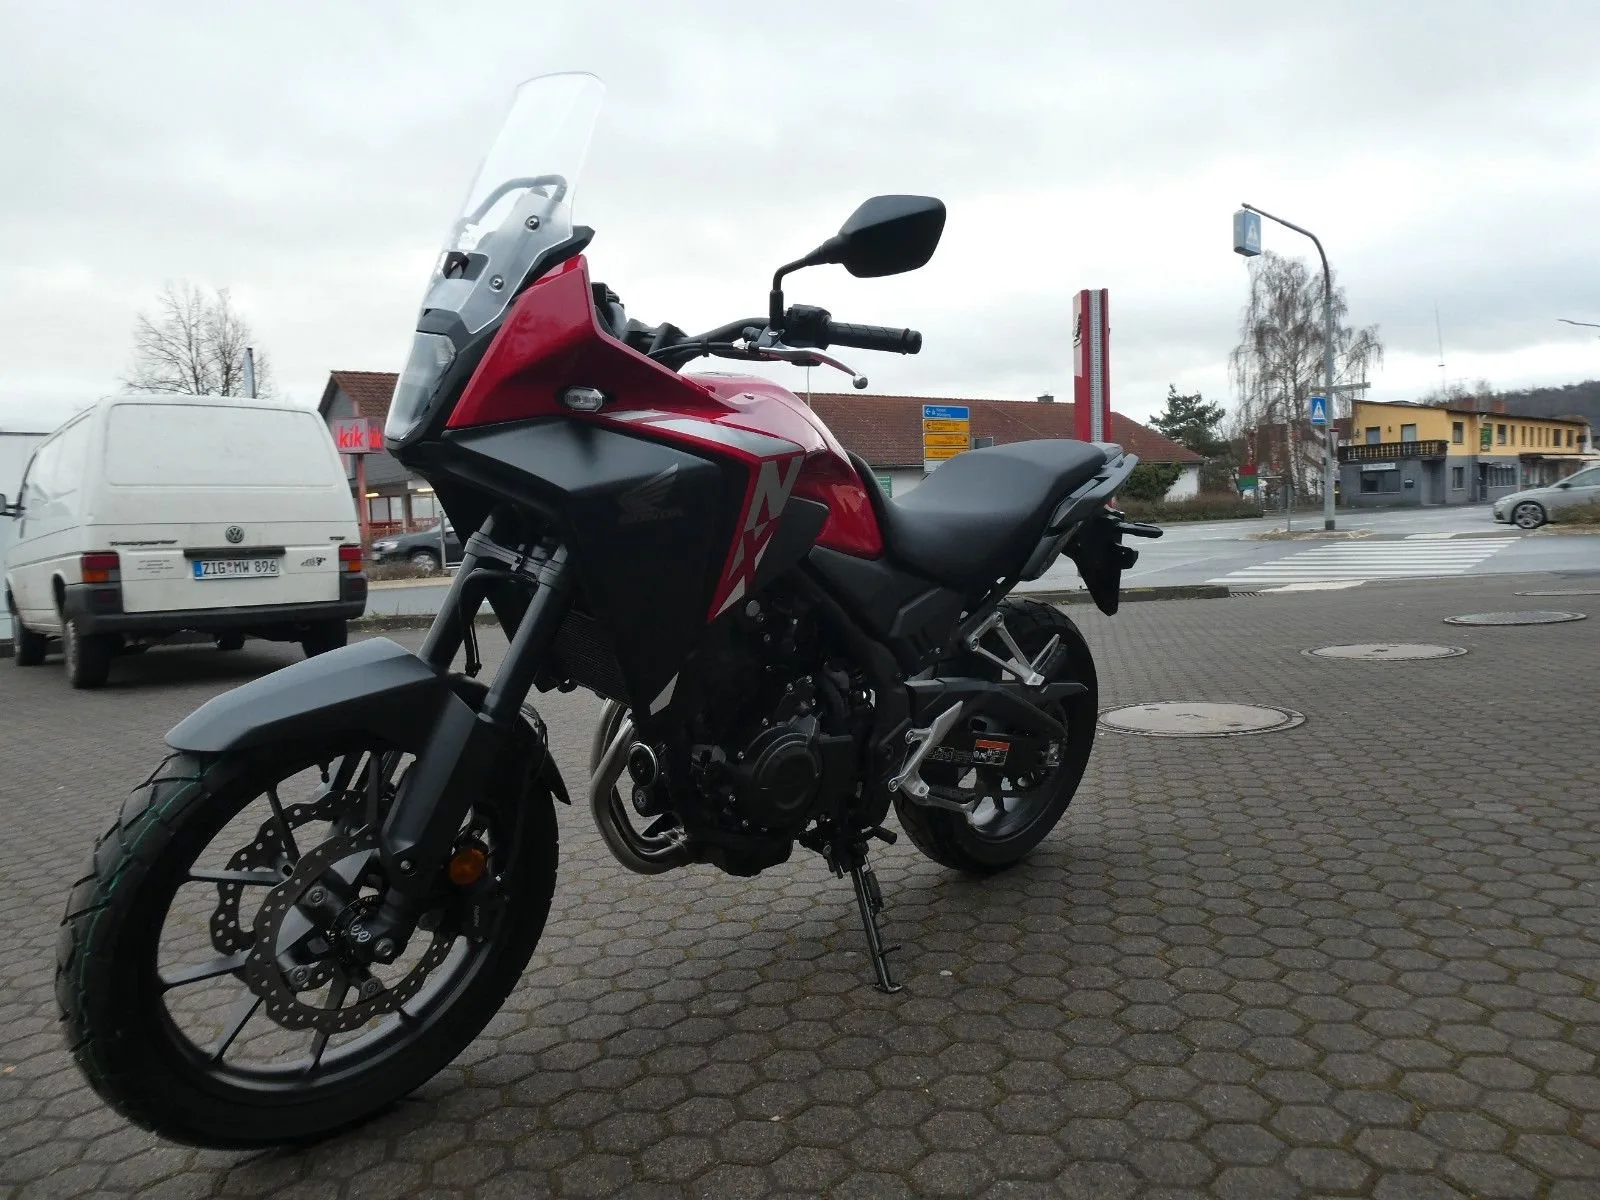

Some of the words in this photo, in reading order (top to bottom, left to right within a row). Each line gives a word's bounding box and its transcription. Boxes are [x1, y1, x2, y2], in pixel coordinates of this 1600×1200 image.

[338, 425, 364, 448] kik
[203, 560, 226, 575] ZIG
[234, 562, 249, 574] MW
[254, 560, 277, 573] 896
